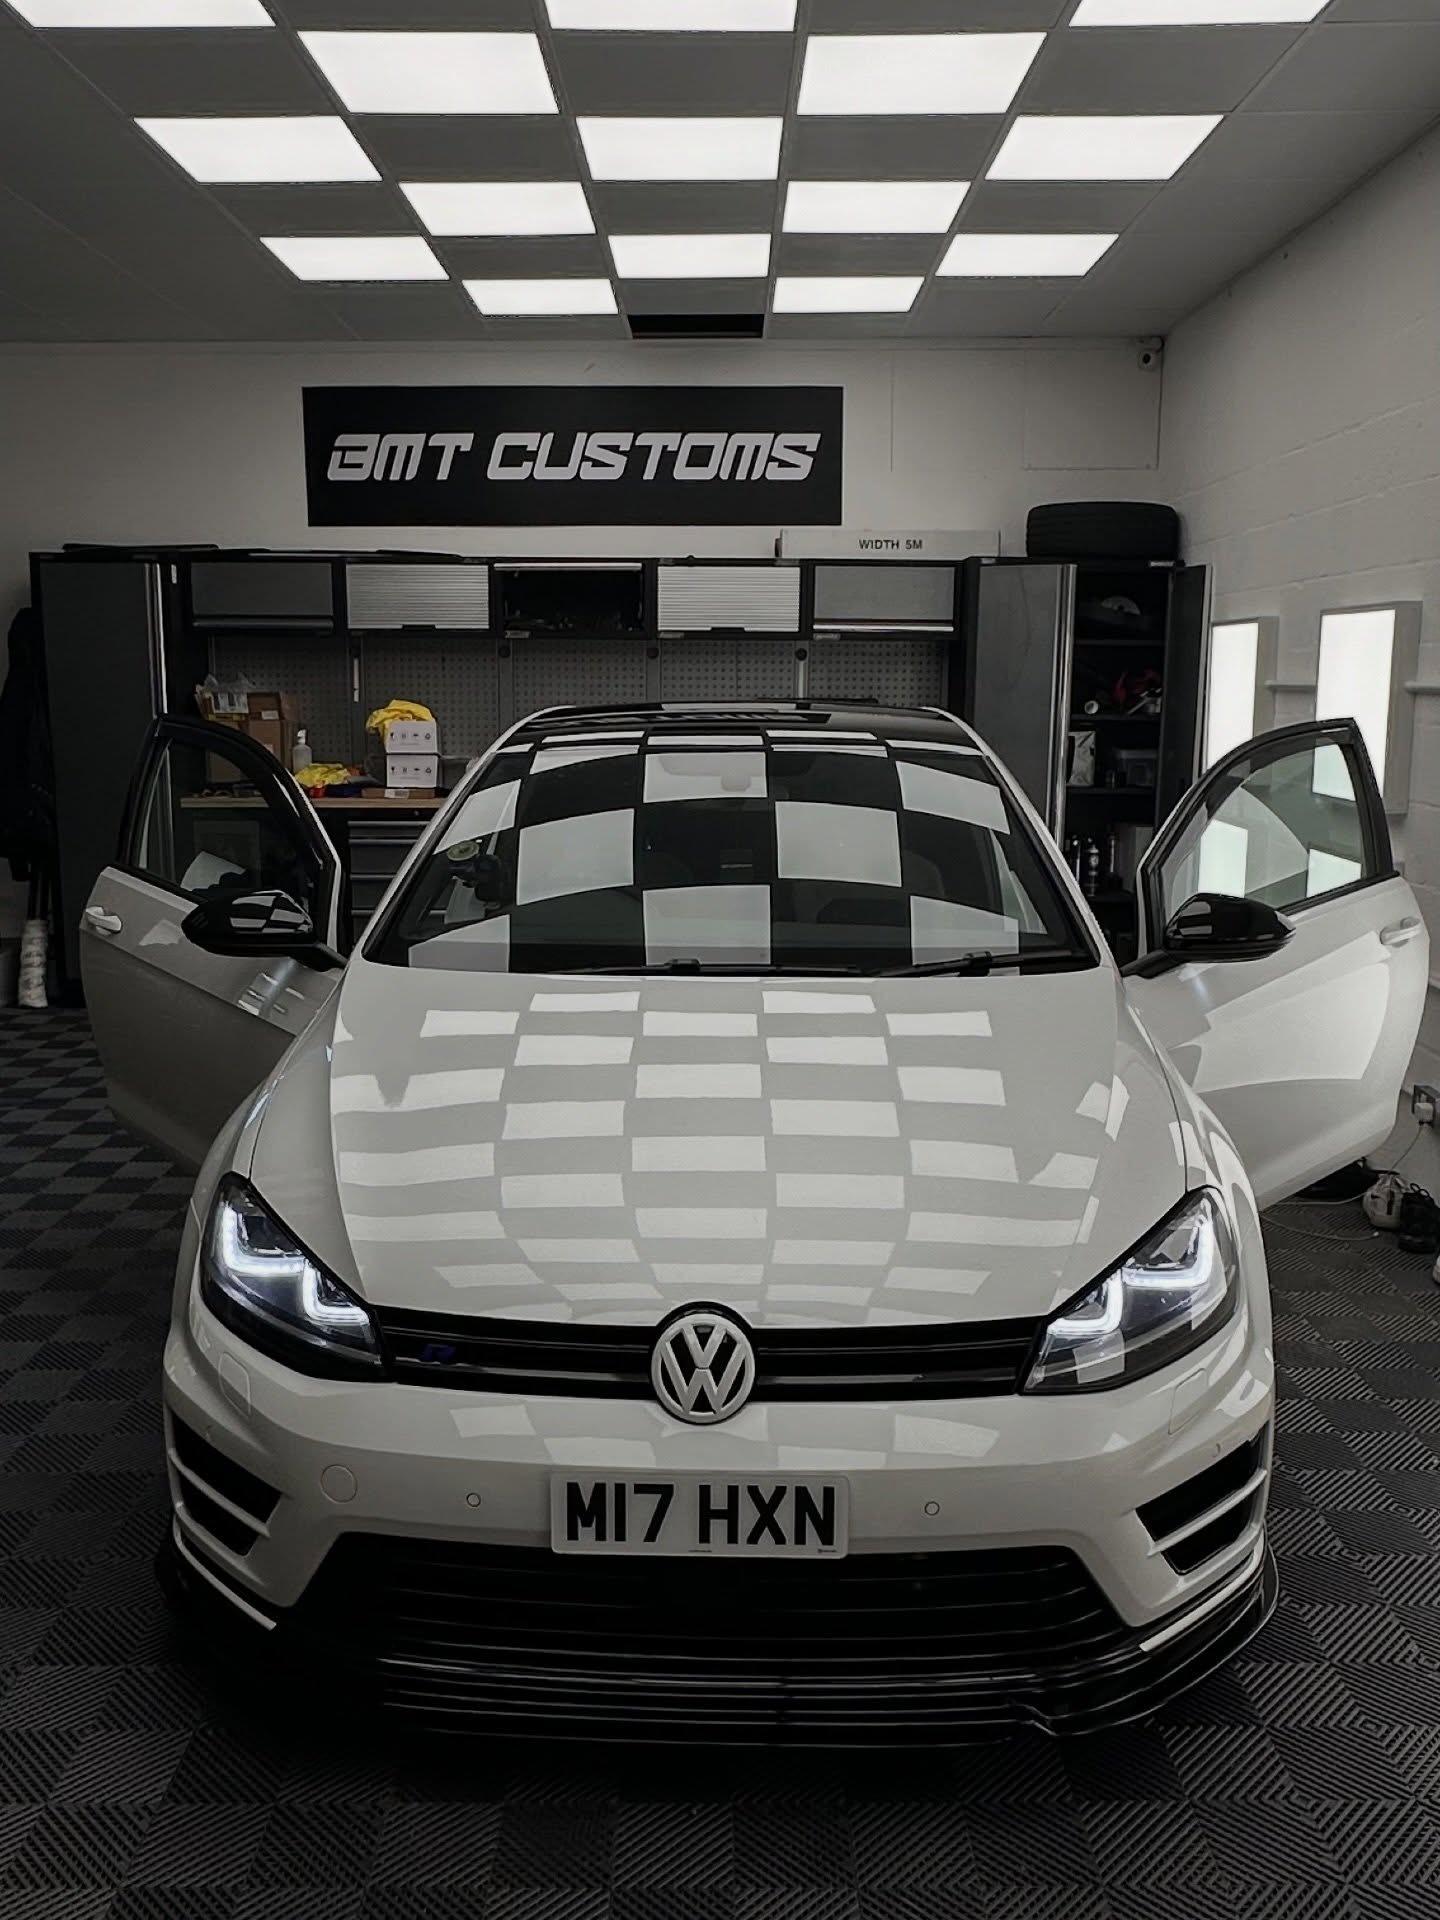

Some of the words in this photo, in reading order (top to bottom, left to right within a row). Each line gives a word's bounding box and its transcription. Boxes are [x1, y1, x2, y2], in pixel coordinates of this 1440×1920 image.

[328, 432, 474, 481] BMT
[487, 432, 821, 481] CUSTOMS
[858, 539, 900, 550] WIDTH
[905, 539, 923, 550] 5M
[656, 1318, 751, 1418] VW
[698, 1484, 836, 1546] HXN
